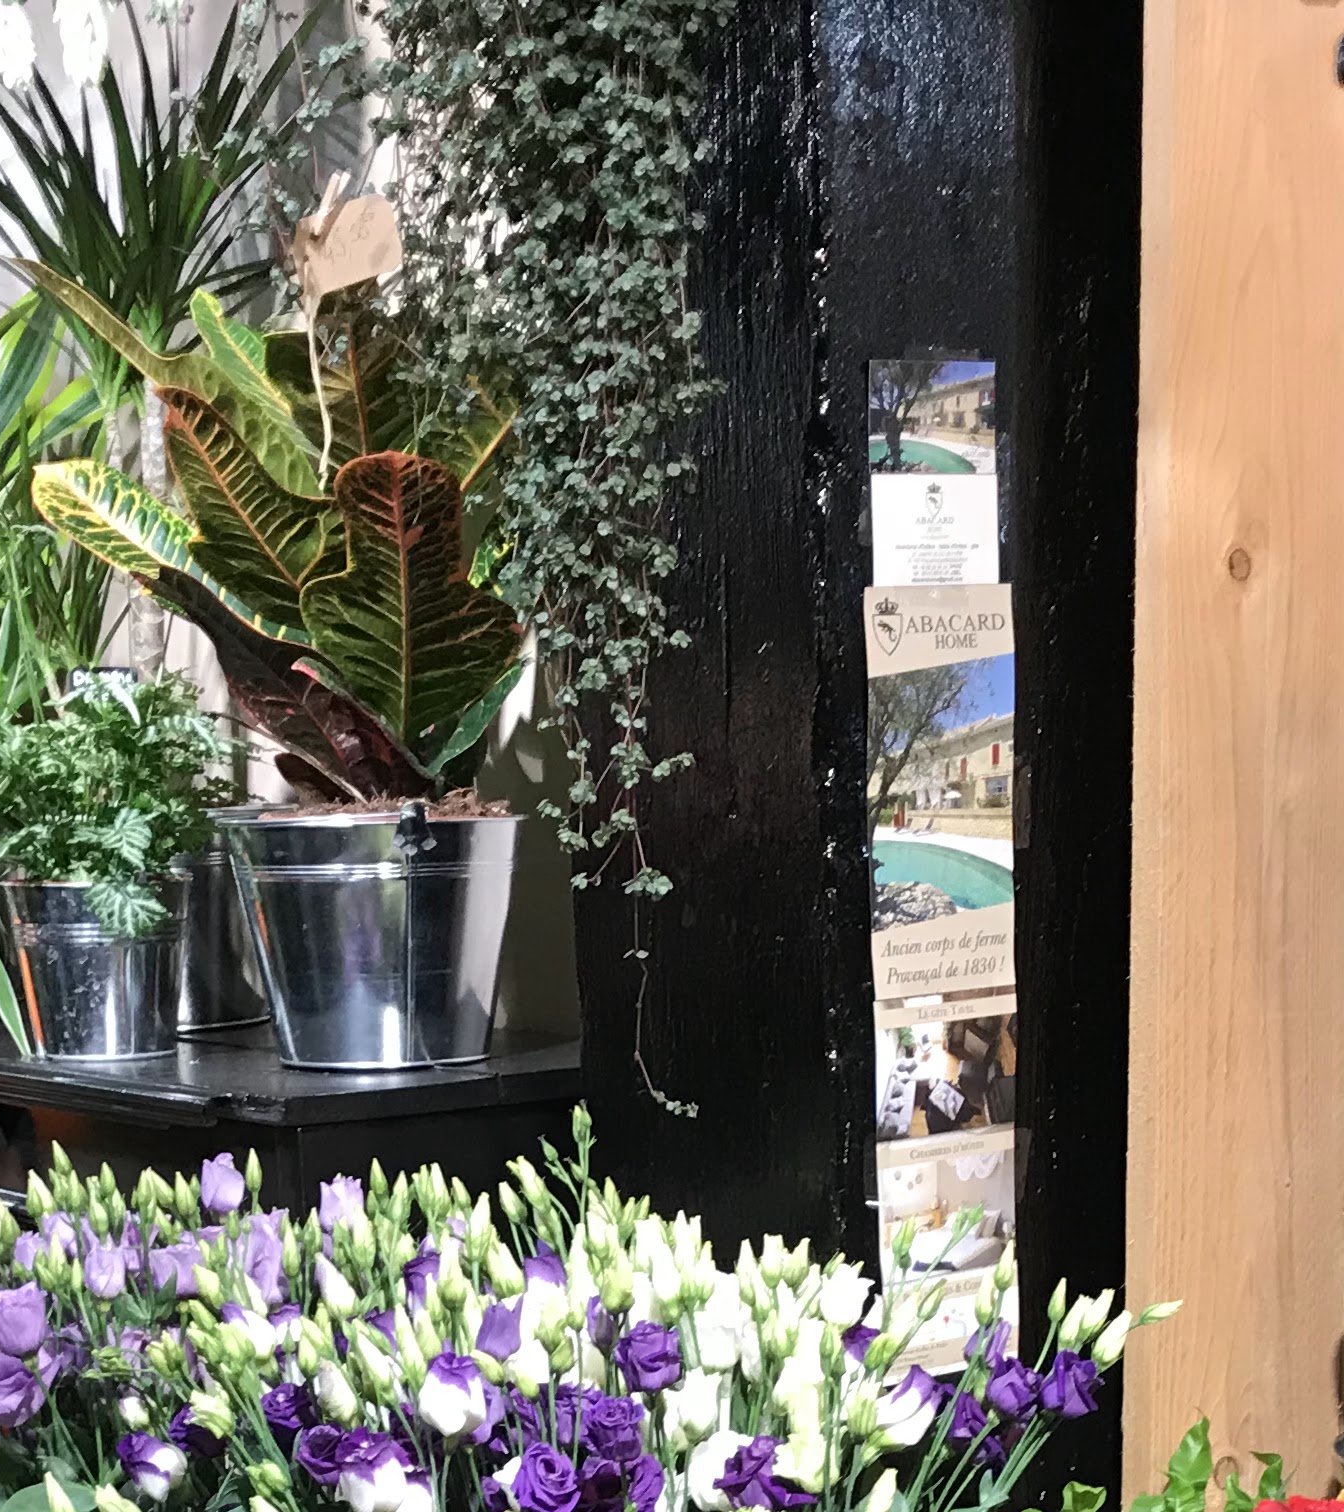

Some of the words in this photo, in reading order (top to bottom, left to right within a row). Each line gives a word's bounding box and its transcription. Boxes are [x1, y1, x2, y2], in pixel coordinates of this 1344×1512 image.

[905, 613, 1006, 634] ABACARD
[935, 633, 979, 650] HOME
[880, 938, 922, 958] Ancien
[924, 937, 956, 957] corps
[958, 931, 972, 948] de
[971, 929, 1008, 953] ferme
[886, 962, 943, 985] Provençal
[945, 960, 960, 978] de
[963, 957, 996, 976] 1830
